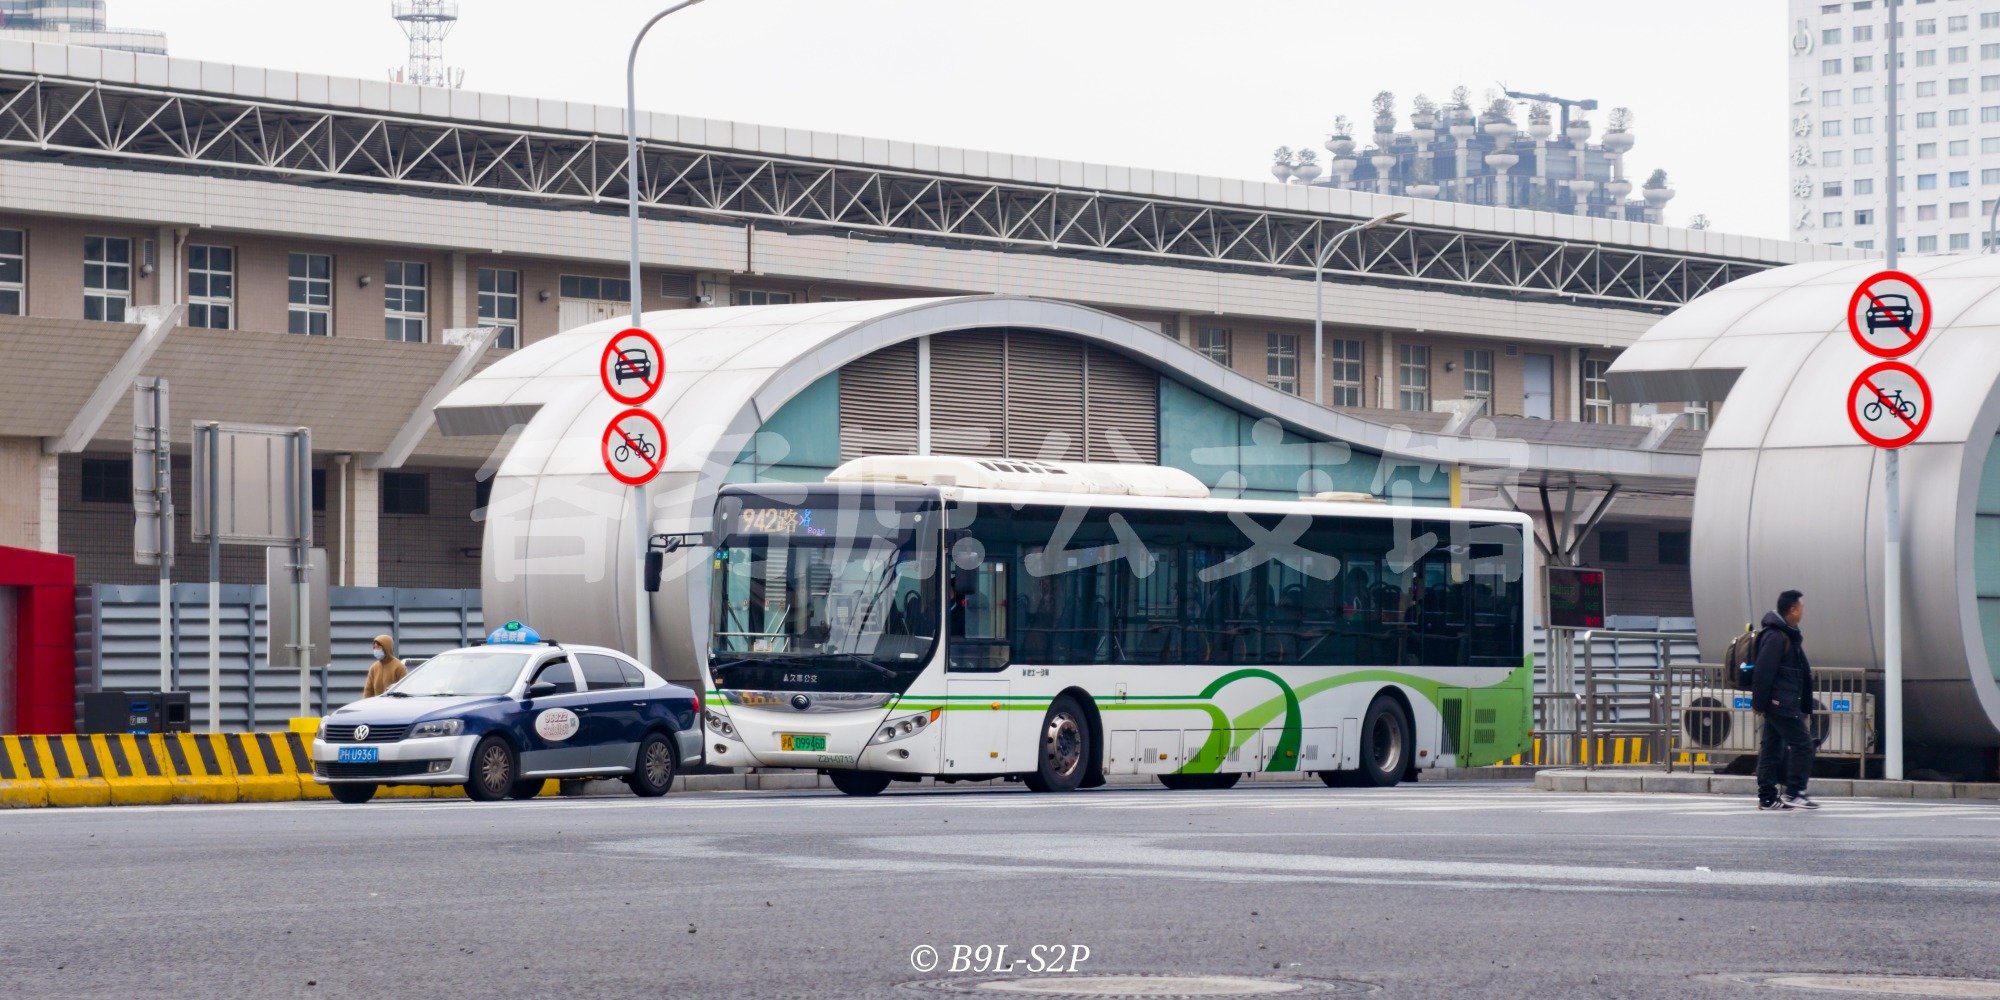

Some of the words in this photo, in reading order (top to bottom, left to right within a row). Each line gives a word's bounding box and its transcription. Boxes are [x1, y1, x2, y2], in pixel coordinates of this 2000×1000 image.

[1792, 84, 1815, 243] 上海铁路大
[743, 508, 798, 533] 942路
